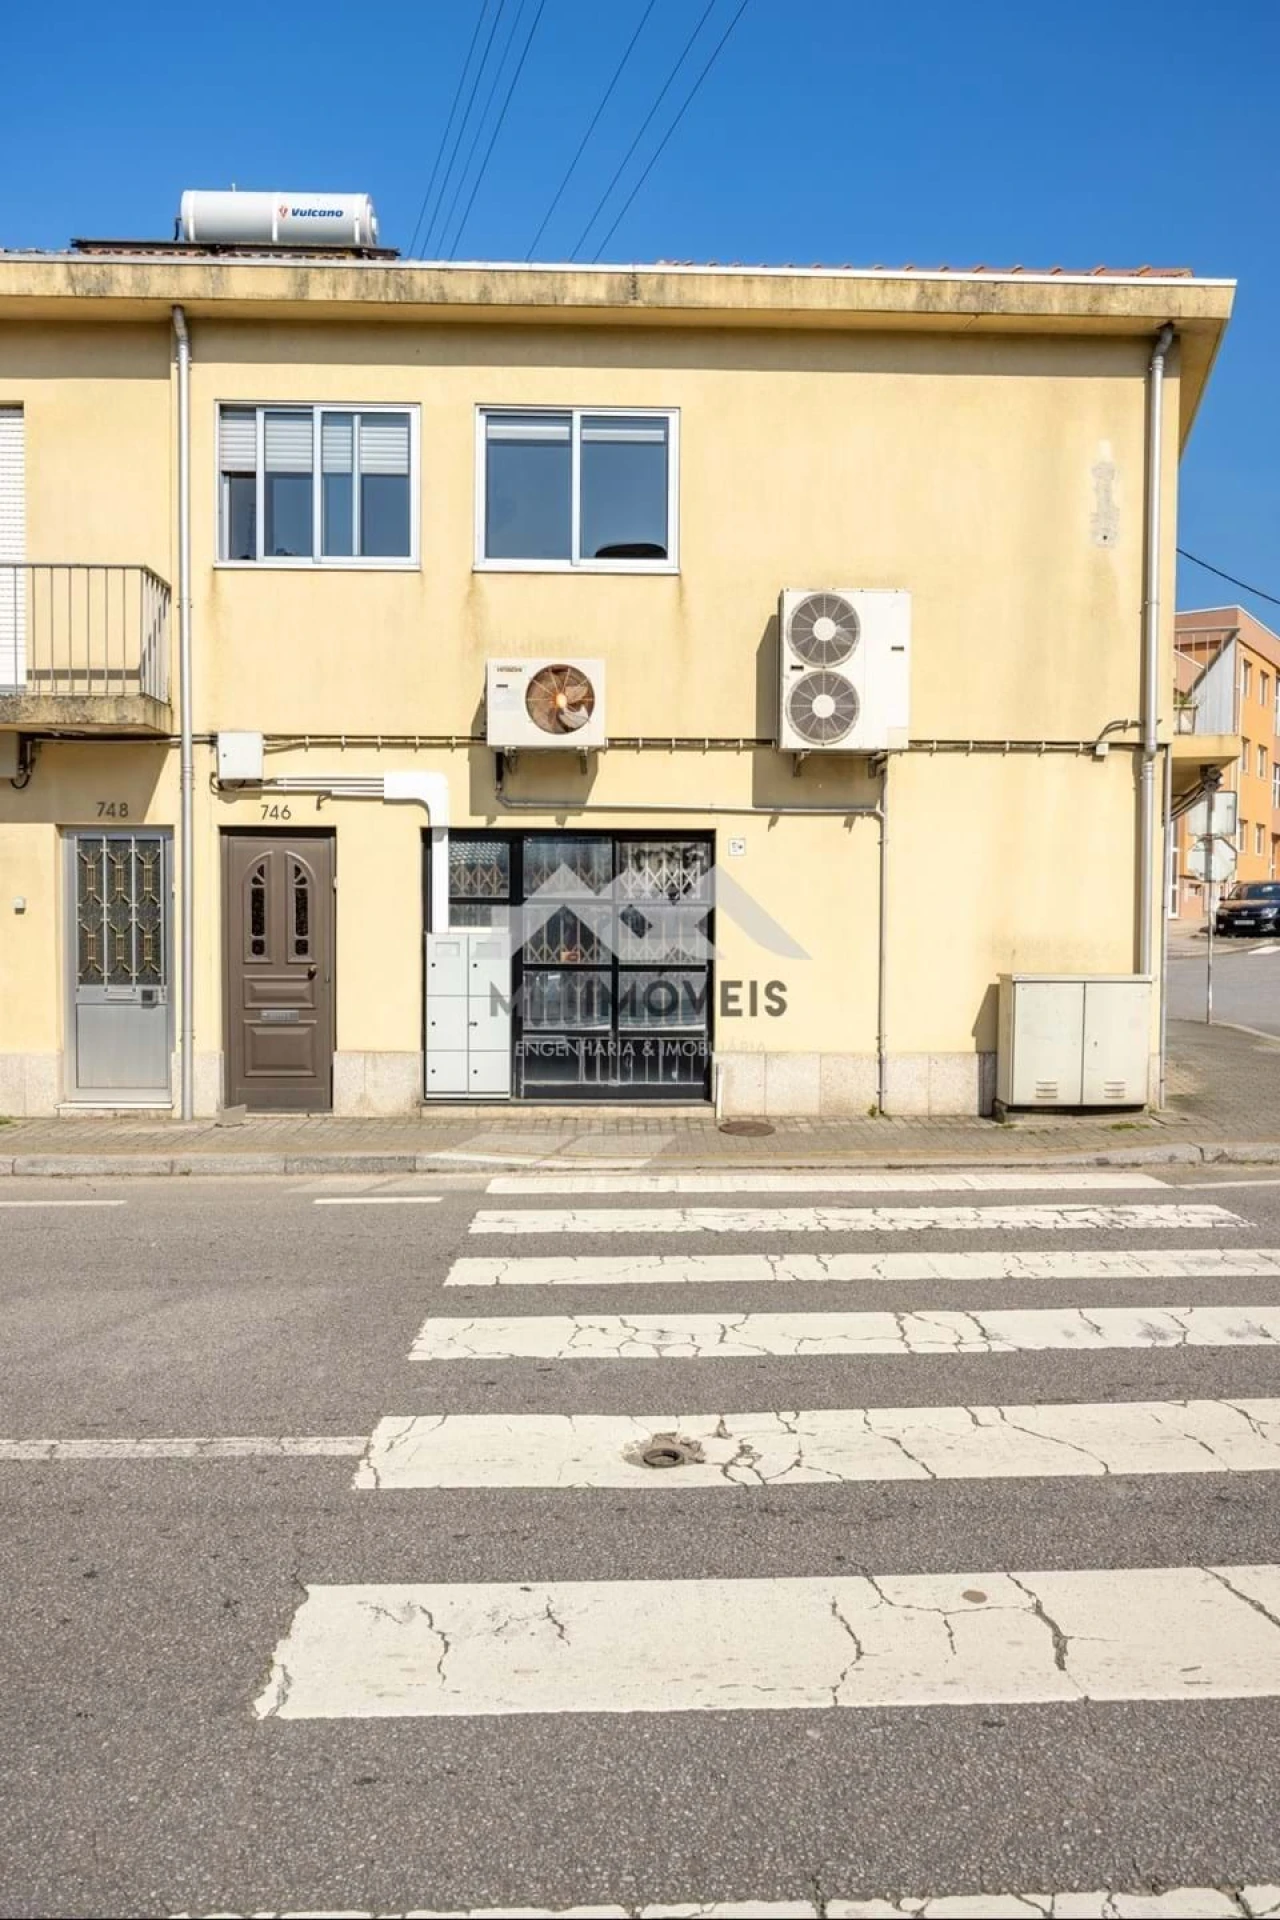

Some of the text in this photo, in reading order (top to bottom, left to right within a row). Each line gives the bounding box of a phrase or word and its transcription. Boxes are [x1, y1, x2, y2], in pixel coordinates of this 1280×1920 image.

[291, 208, 344, 217] Vulcano
[96, 801, 129, 818] 748
[260, 804, 292, 821] 746
